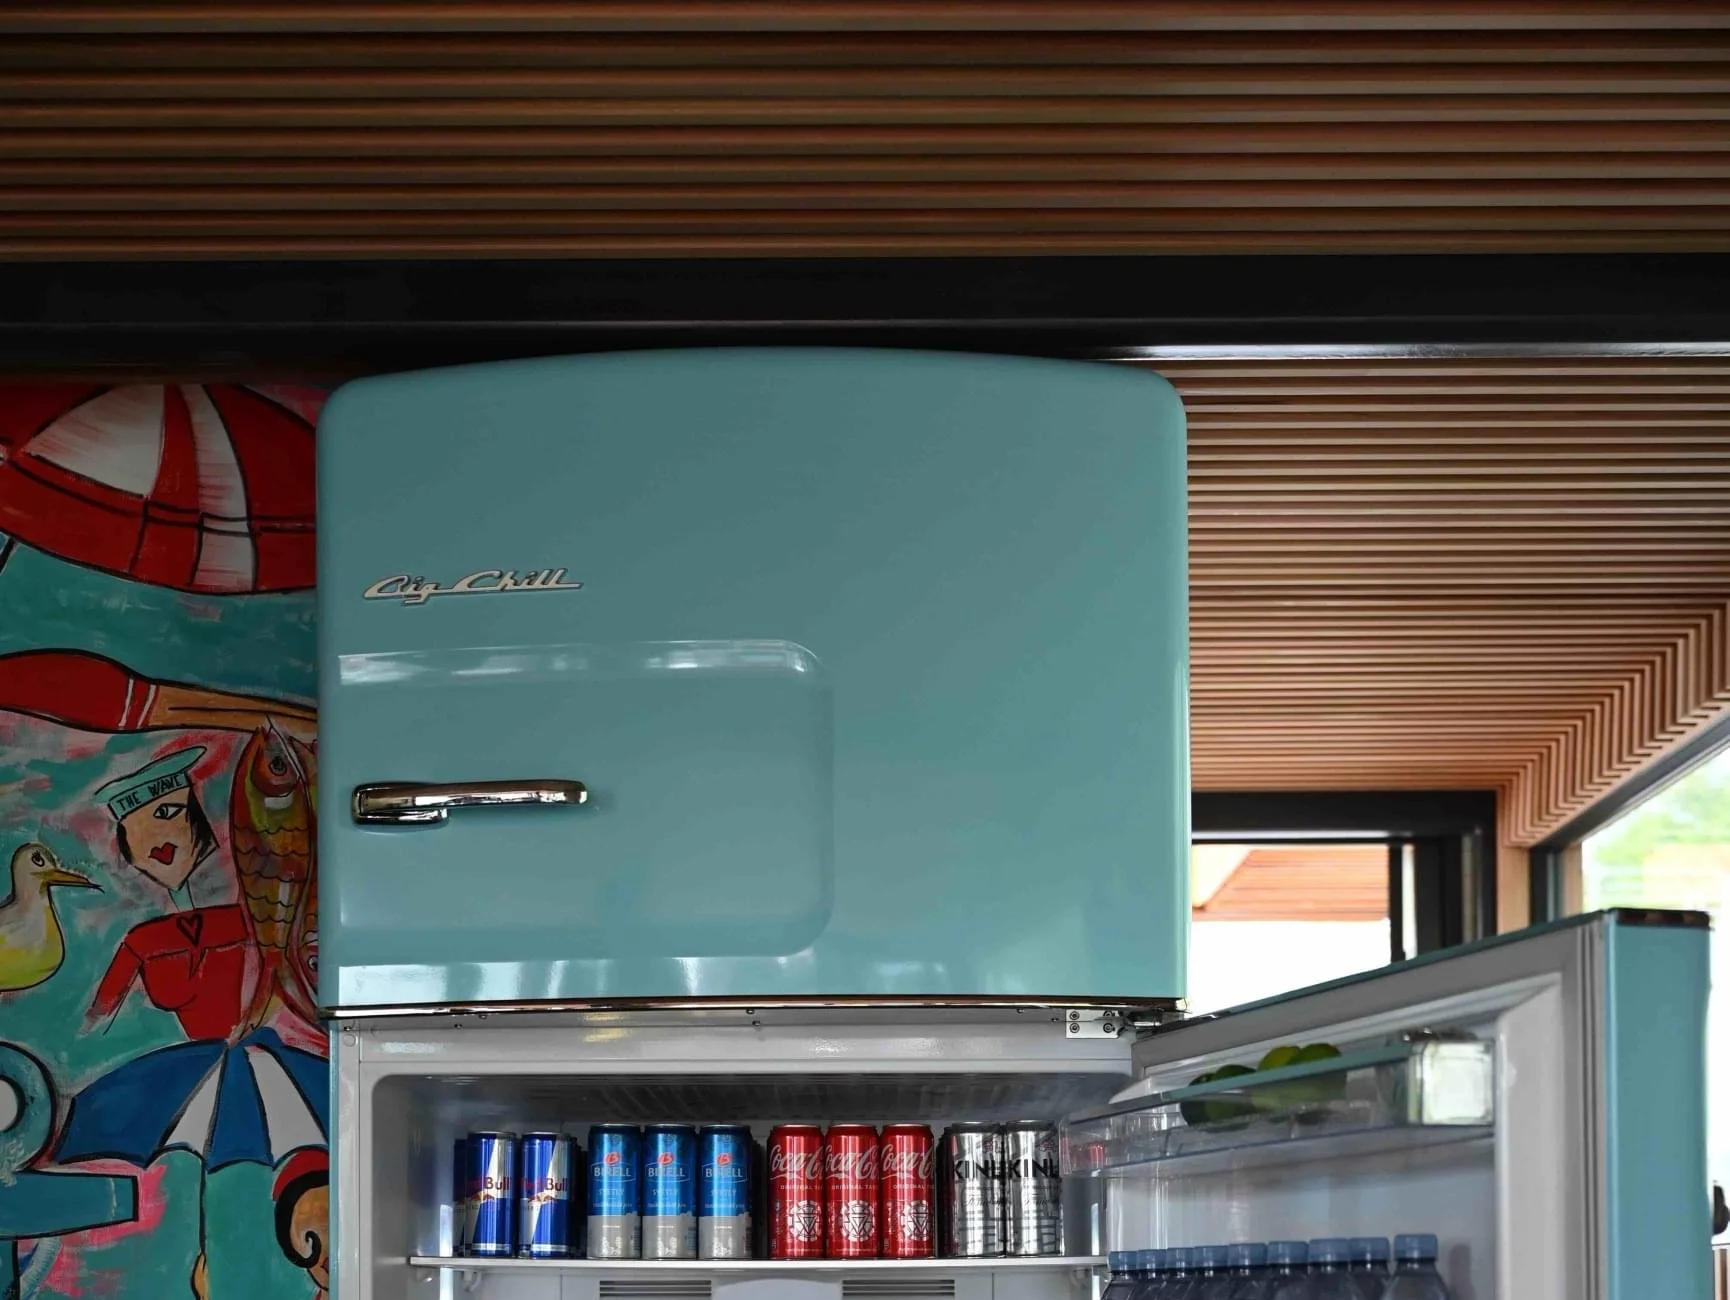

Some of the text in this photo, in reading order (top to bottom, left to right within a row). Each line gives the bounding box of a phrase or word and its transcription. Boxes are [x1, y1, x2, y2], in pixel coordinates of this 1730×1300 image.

[449, 567, 582, 593] Chill
[116, 774, 182, 811] THE WAVE
